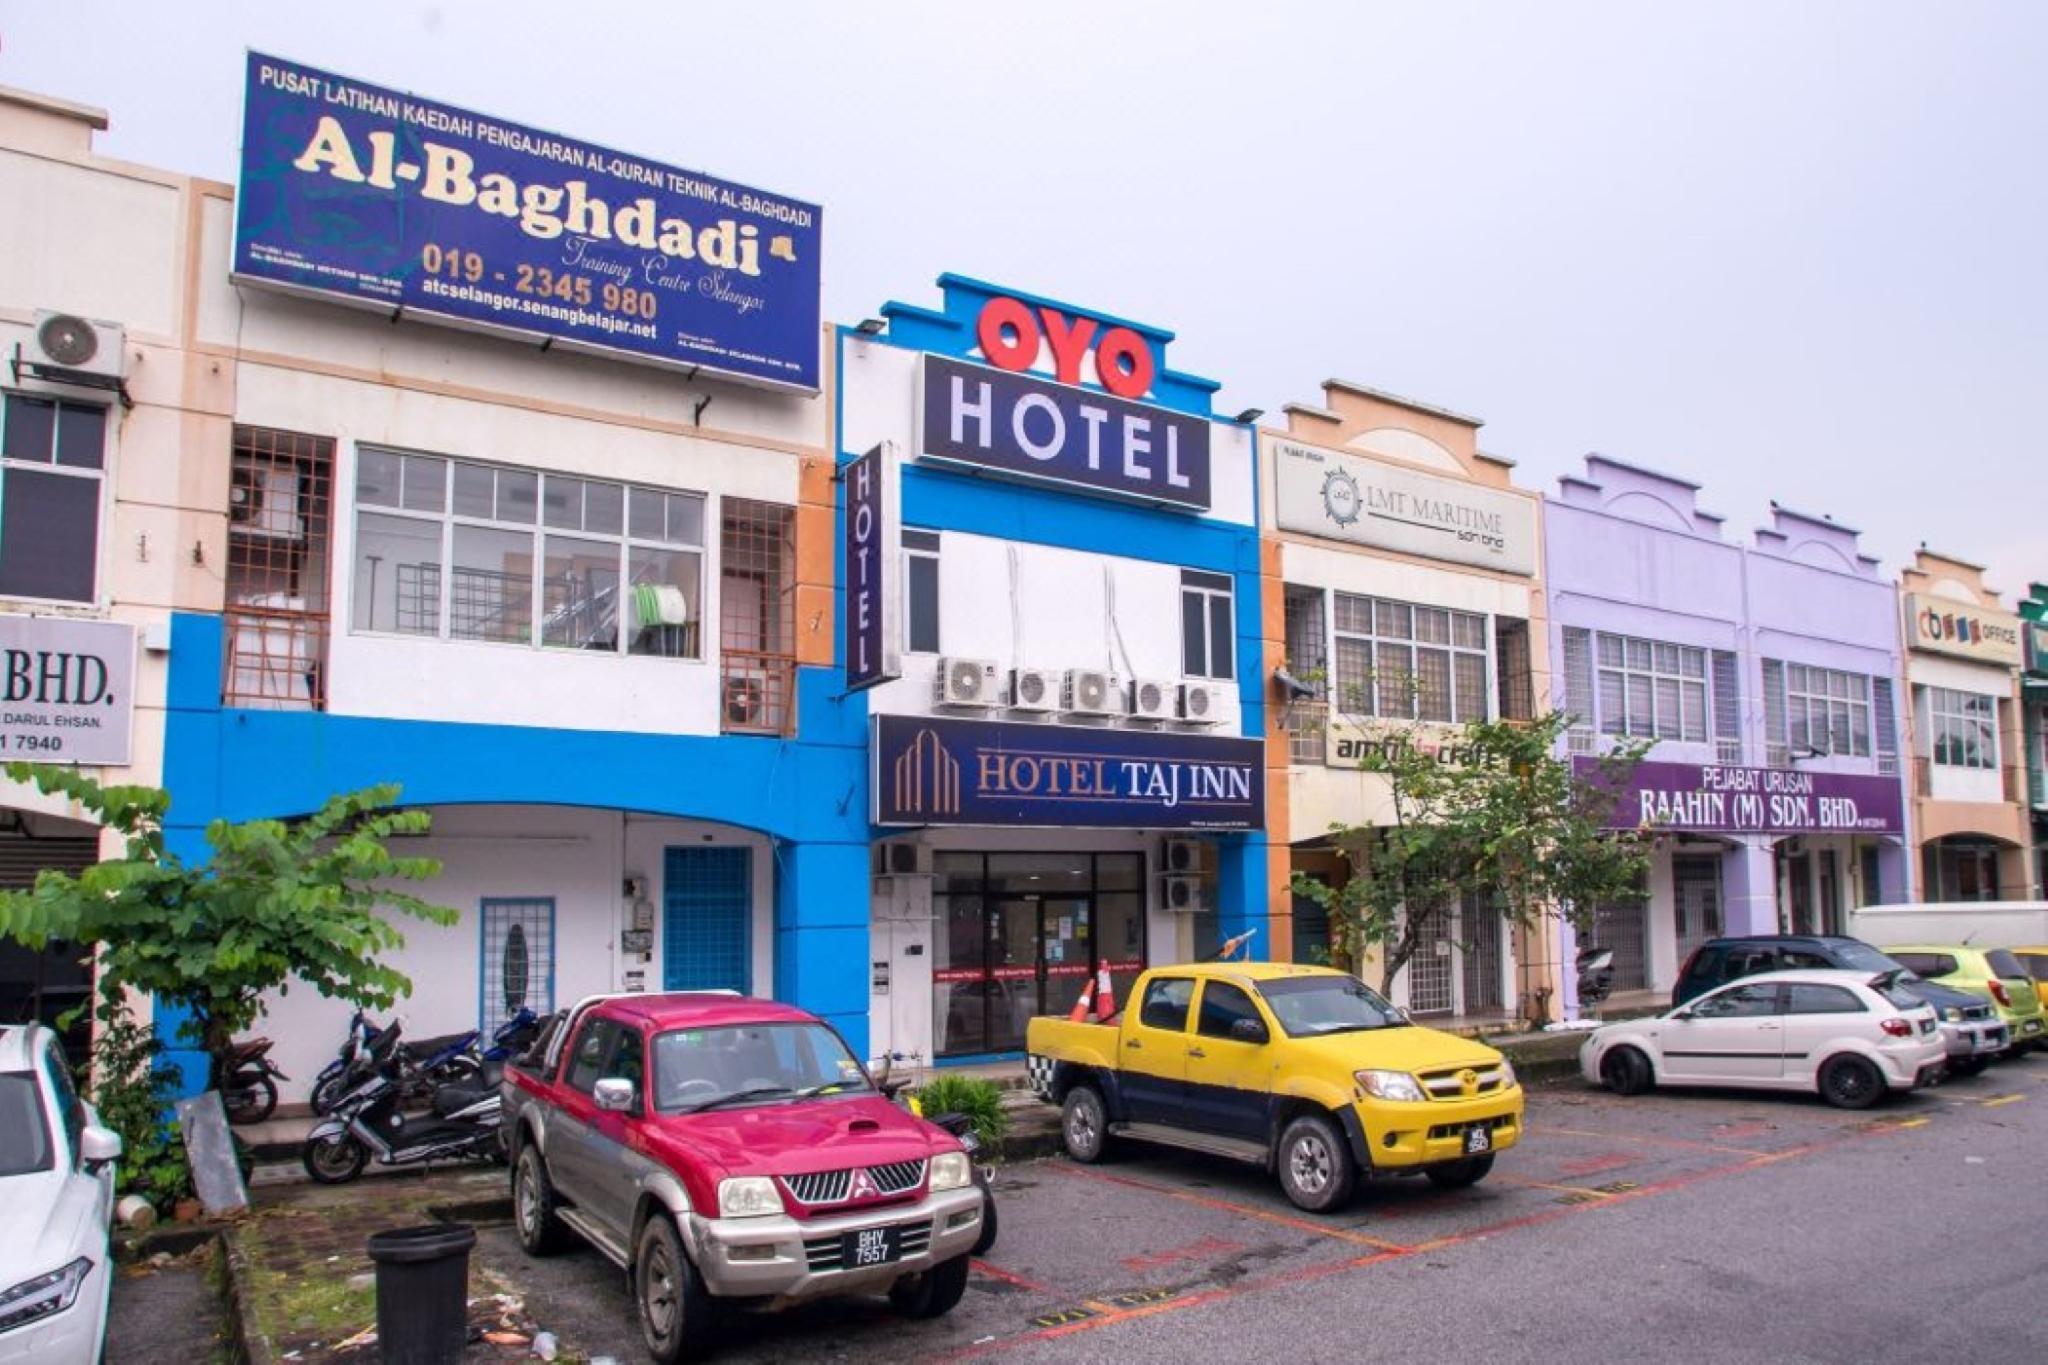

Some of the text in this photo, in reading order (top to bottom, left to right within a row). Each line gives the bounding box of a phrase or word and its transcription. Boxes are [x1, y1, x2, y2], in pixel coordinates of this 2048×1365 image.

[261, 65, 812, 228] PUSAT LATIHAN KAEDAH PENGAJARAN AL-QURAN TEKNIK AL-BAGHDADI
[293, 115, 761, 277] Al-Baghdadi
[422, 243, 484, 282] 019
[516, 263, 592, 306] 2345
[603, 283, 657, 320] 980
[561, 235, 632, 287] Training
[698, 270, 764, 315] Selangor
[422, 276, 657, 340] atcselangor.senangbelajar.net
[976, 296, 1155, 401] OYO
[949, 375, 1191, 489] HOTEL
[1367, 485, 1503, 535] LMT MARITIME
[855, 457, 873, 674] HOTEL
[3, 648, 115, 706] BHD.
[3, 712, 50, 726] DARUL
[16, 735, 62, 751] 7940
[976, 754, 1253, 808] HOTEL TAJ INN
[1639, 788, 1863, 829] RAAHIN (M) SDN. BHD.
[1703, 766, 1813, 794] PEJABAT URUSAN
[855, 1244, 889, 1265] 7557
[858, 1229, 885, 1249] BHY
